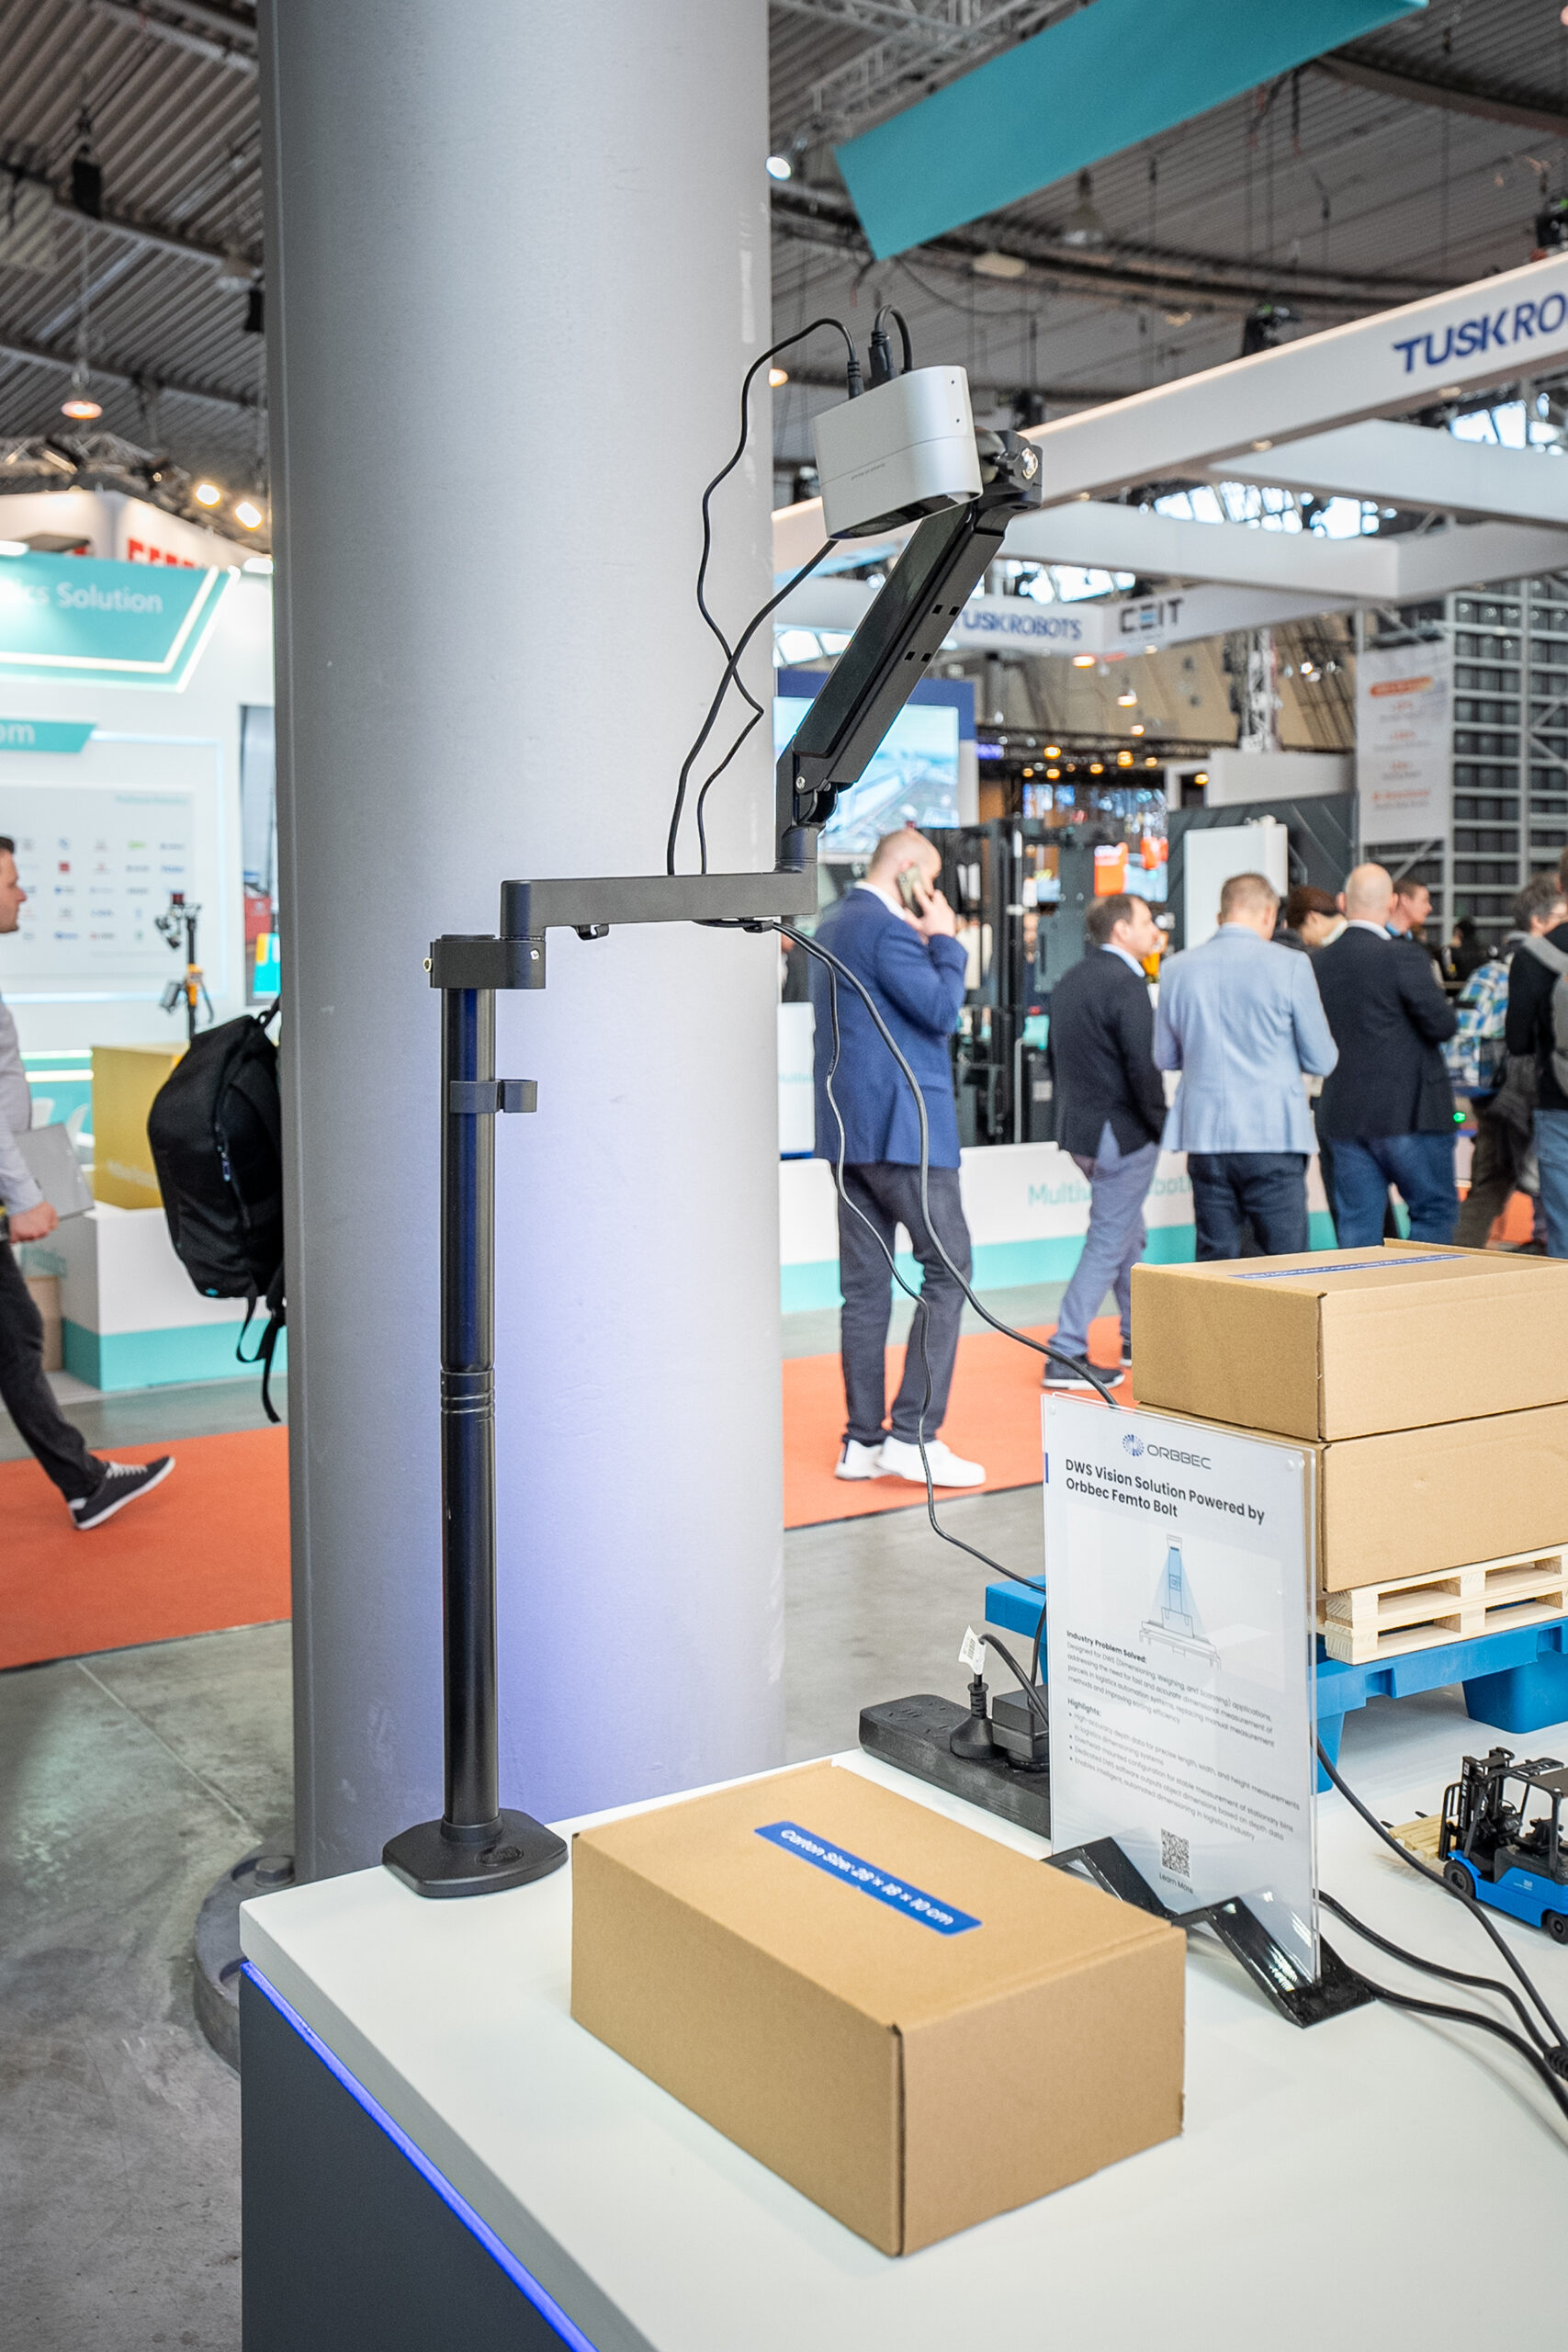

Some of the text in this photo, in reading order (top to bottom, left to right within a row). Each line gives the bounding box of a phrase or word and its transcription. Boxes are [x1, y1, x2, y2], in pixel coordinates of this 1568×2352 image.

[56, 582, 164, 614] Solution
[1146, 1442, 1211, 1470] ORBBEC
[1066, 1458, 1265, 1526] DWS Vision Solution Powered by
[1066, 1476, 1177, 1518] Orbbec Femto Bolt
[1066, 1630, 1146, 1664] Industry Problem Solved:
[1066, 1641, 1092, 1657] Designed
[1102, 1654, 1114, 1664] DWS
[1186, 1684, 1198, 1694] and
[1067, 1674, 1091, 1690] methods
[1093, 1684, 1103, 1694] and
[1105, 1689, 1131, 1705] improving
[1067, 1652, 1098, 1670] addressing
[1099, 1663, 1107, 1672] the
[1109, 1667, 1122, 1678] need
[1132, 1675, 1142, 1685] fast
[1144, 1680, 1154, 1690] and
[1156, 1684, 1181, 1701] accurate
[1182, 1695, 1218, 1714] dimensional
[1220, 1709, 1264, 1731] measurement
[1266, 1724, 1272, 1735] of
[1067, 1663, 1088, 1678] parcels
[1089, 1670, 1094, 1679] in
[1095, 1673, 1116, 1688] logistics
[1118, 1682, 1148, 1700] automation
[1176, 1704, 1203, 1723] replacing
[1205, 1715, 1228, 1730] manual
[1230, 1724, 1274, 1747] measurement
[1067, 1697, 1100, 1718] Highlights:
[1080, 1726, 1100, 1741] logistics
[1102, 1735, 1138, 1757] dimensioning
[1113, 1728, 1130, 1742] depth
[1131, 1736, 1145, 1747] data
[1155, 1745, 1176, 1760] precise
[1217, 1770, 1229, 1781] and
[1231, 1774, 1249, 1791] height
[1252, 1783, 1299, 1810] measurements
[1128, 1757, 1165, 1780] configuration
[1167, 1772, 1175, 1781] for
[1176, 1776, 1193, 1791] stable
[1196, 1785, 1237, 1808] measurement
[1247, 1806, 1278, 1826] stationary
[1280, 1820, 1292, 1832] bins
[1115, 1763, 1139, 1780] software
[1140, 1773, 1161, 1789] outputs
[1163, 1783, 1180, 1798] object
[1182, 1792, 1216, 1812] dimensions
[1218, 1806, 1237, 1821] based
[1239, 1815, 1247, 1825] on
[1248, 1819, 1267, 1834] depth
[1268, 1827, 1283, 1840] data
[1123, 1778, 1155, 1797] automated
[1156, 1791, 1195, 1817] dimensioning
[1197, 1809, 1201, 1817] in
[1203, 1812, 1227, 1830] logistics
[781, 1829, 825, 1857] Carton
[823, 1852, 855, 1872] Size:
[909, 1898, 931, 1911] 10
[926, 1907, 954, 1926] cm
[1158, 1871, 1193, 1894] Learn More
